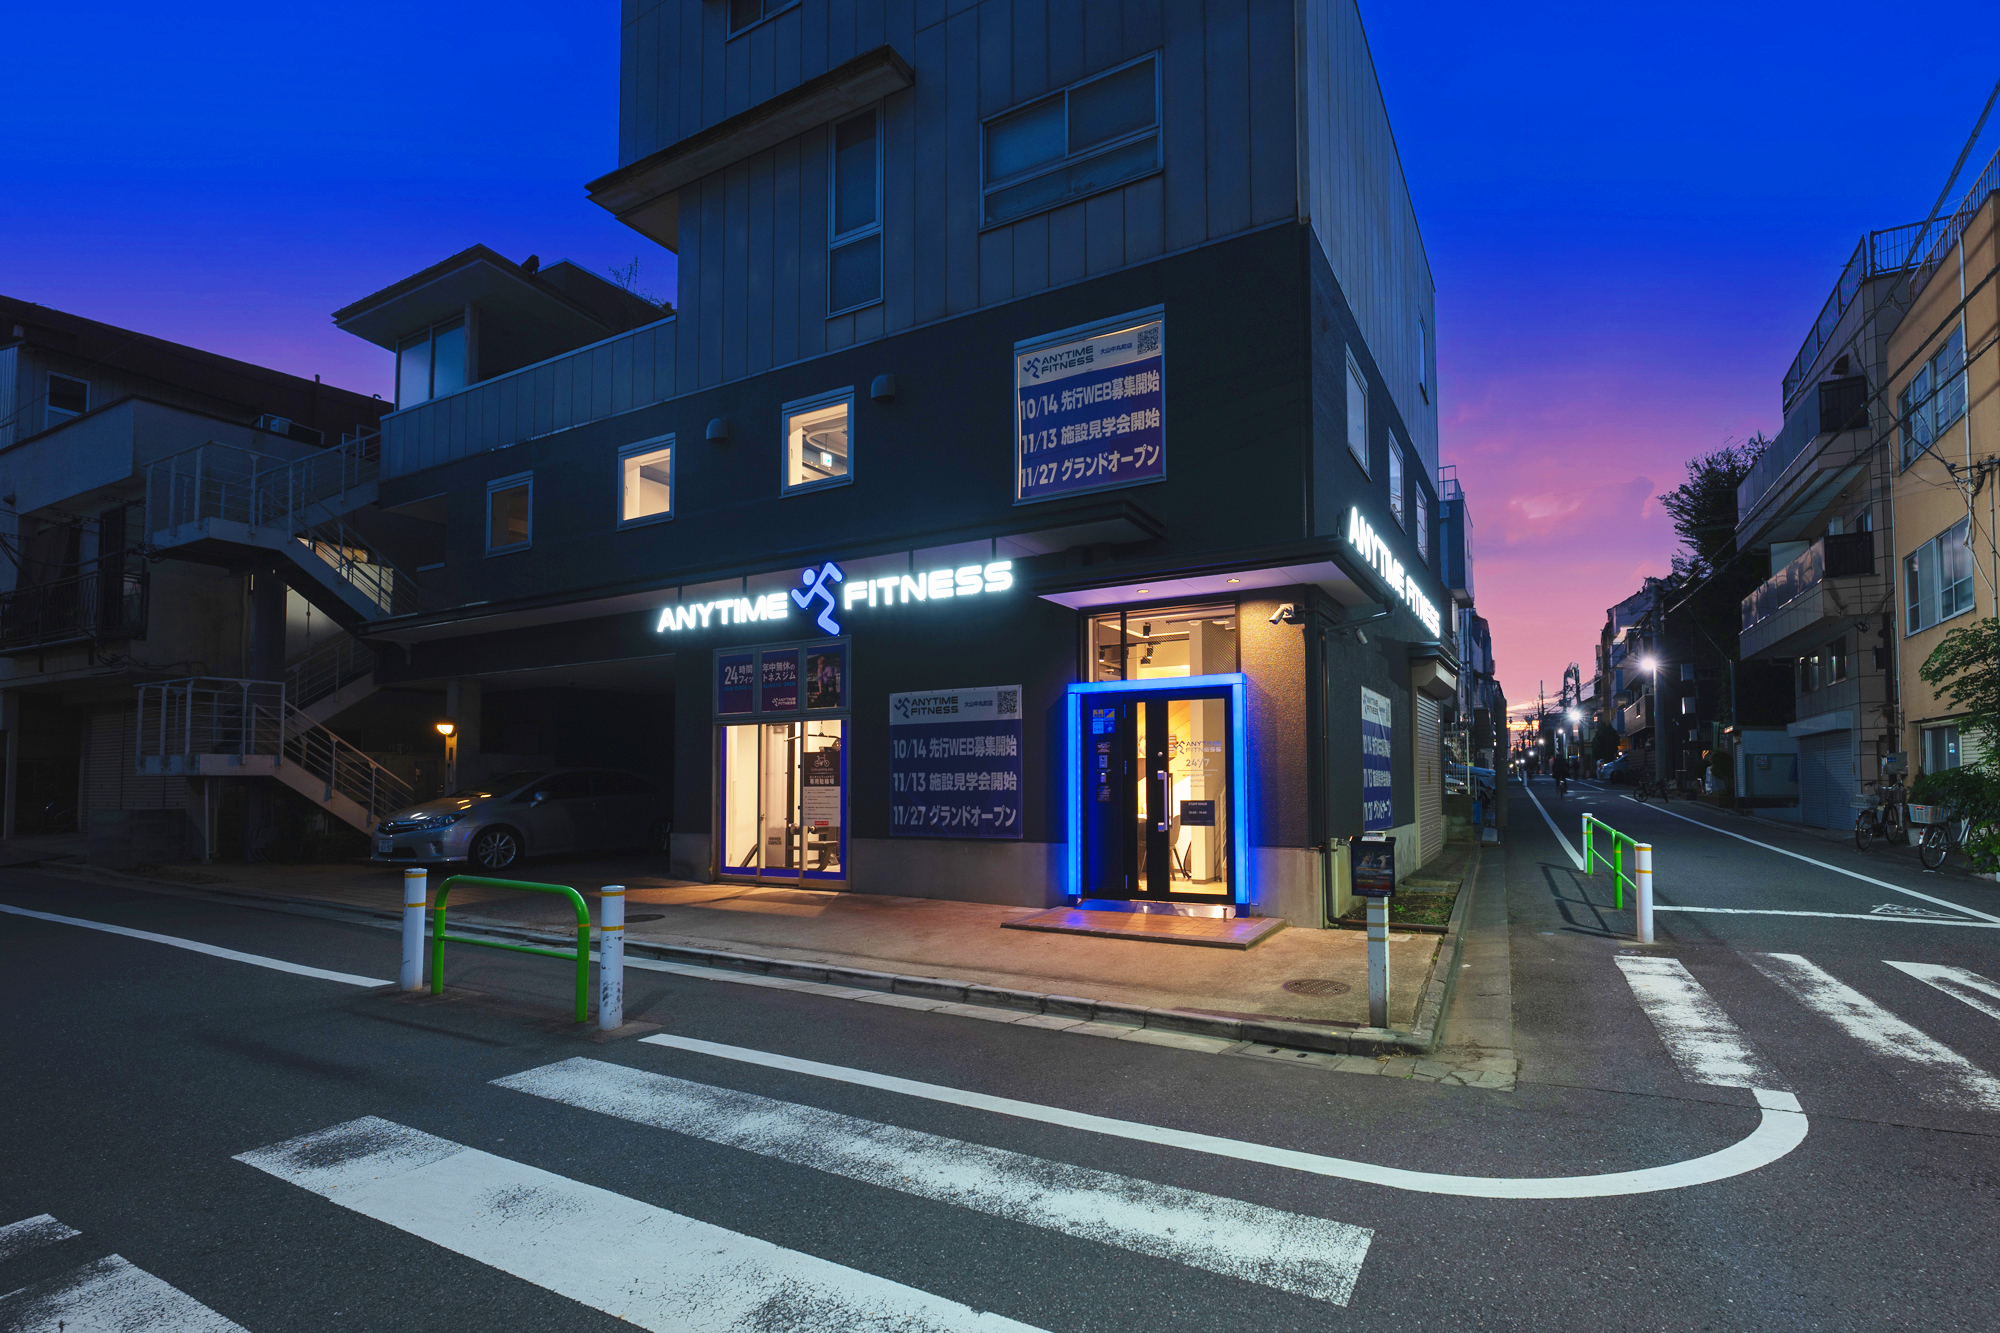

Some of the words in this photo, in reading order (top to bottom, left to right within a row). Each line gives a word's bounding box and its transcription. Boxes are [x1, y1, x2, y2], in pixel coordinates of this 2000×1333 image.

[1041, 345, 1094, 366] ANYTIME
[1041, 357, 1094, 375] FITNESS
[1021, 394, 1058, 420] 10/14
[1061, 370, 1160, 412] 先行WEB募集開始
[1022, 428, 1057, 454] 11/13
[1061, 408, 1160, 446] 施設見学会開始
[1021, 462, 1057, 488] 11/27
[1061, 443, 1160, 482] グランドオープン
[1349, 506, 1405, 600] ANYTIME
[1406, 575, 1440, 638] FITNESS
[657, 592, 789, 634] ANYTIME
[844, 561, 1013, 611] FITNESS
[762, 661, 796, 672] 年中無休の
[762, 671, 796, 683] トネスジム
[911, 696, 959, 706] ANYTIME
[911, 704, 959, 715] FITNESS
[893, 739, 926, 758] 10/14
[929, 735, 1017, 758] 先行WEB募集開始
[893, 773, 926, 792] 11/13
[929, 771, 1017, 791] 施設見学会開始
[893, 805, 926, 825] 11/27
[929, 805, 1017, 827] グランドオープン
